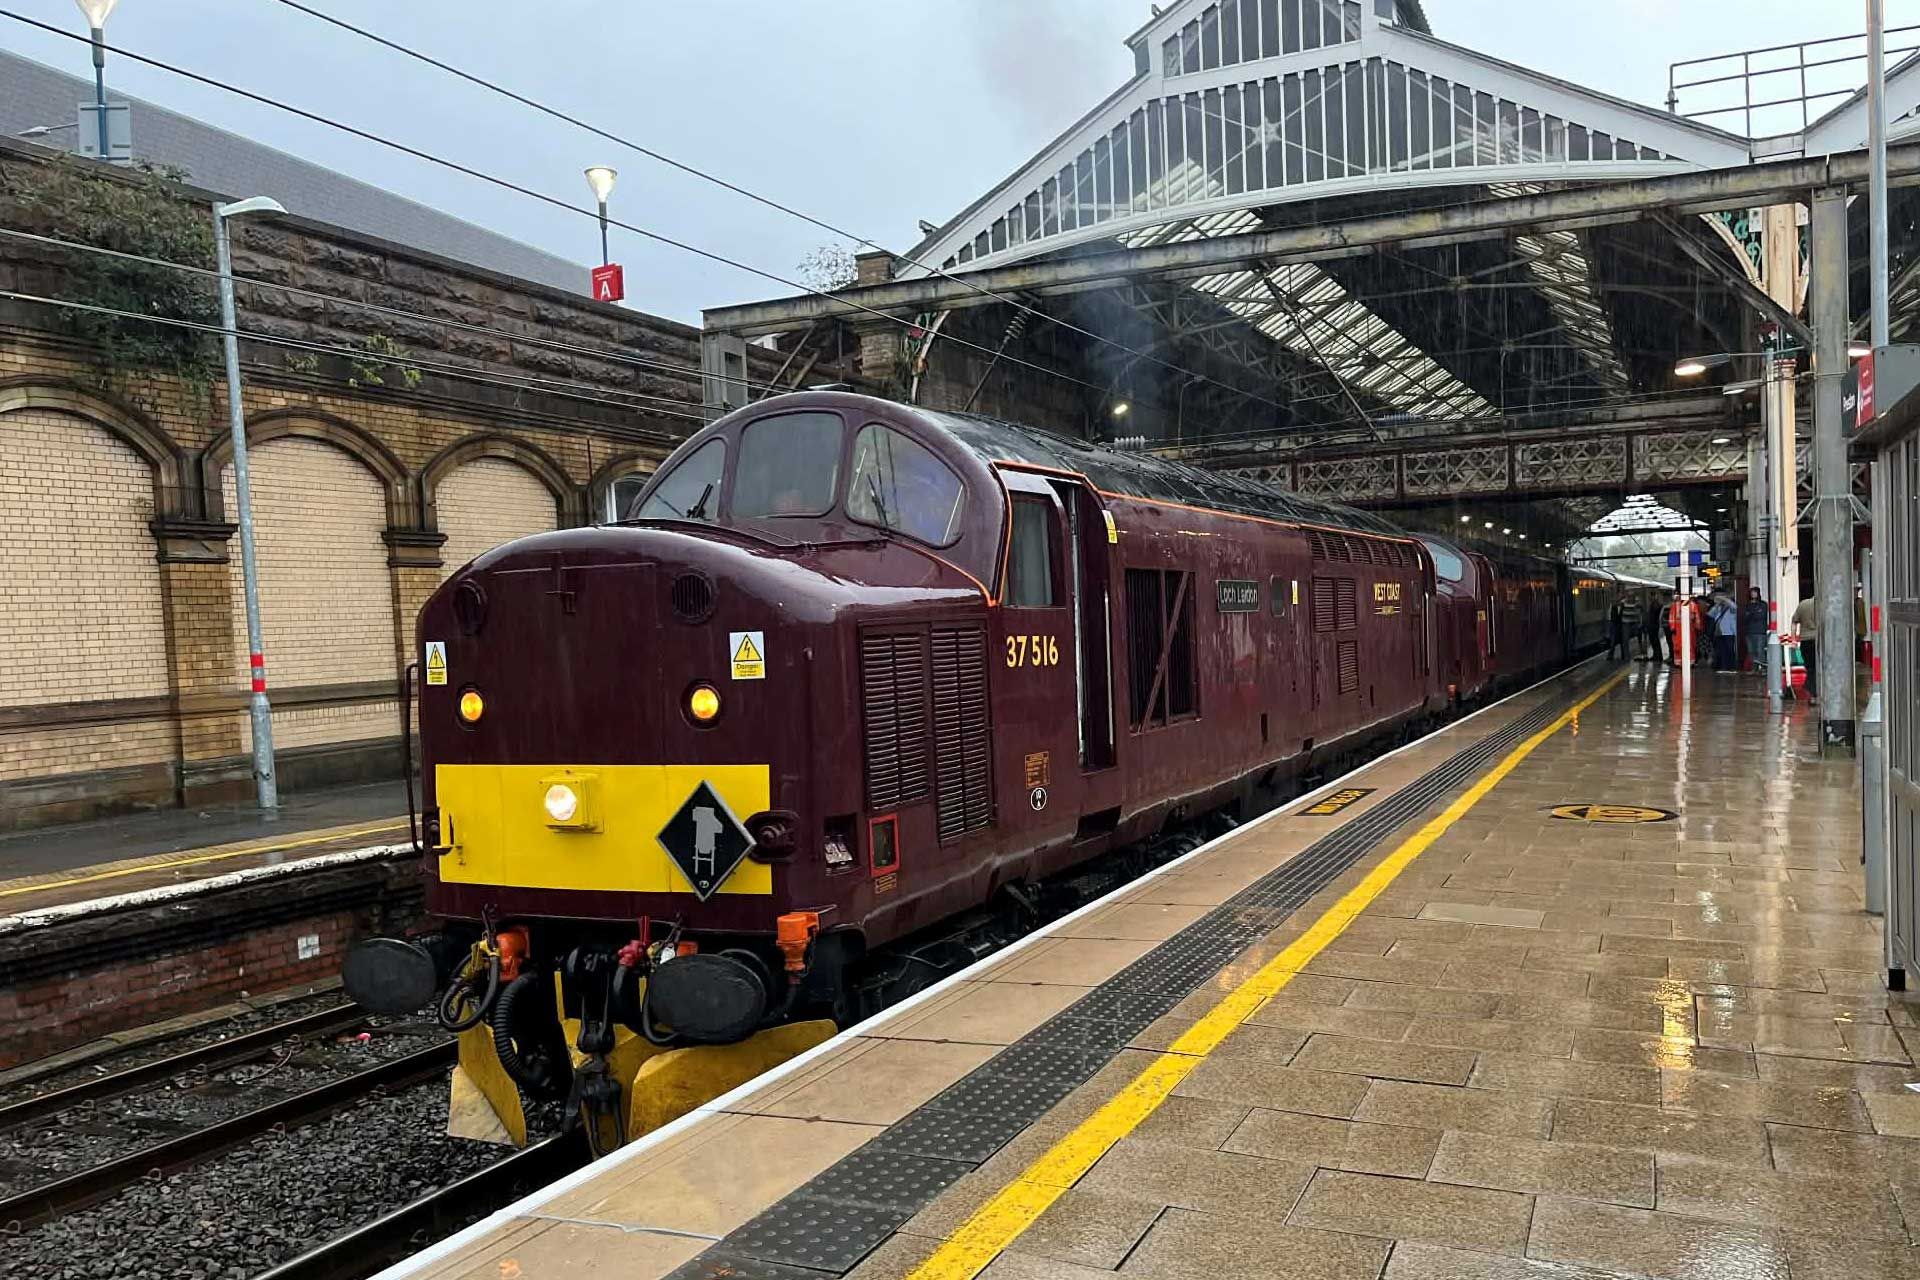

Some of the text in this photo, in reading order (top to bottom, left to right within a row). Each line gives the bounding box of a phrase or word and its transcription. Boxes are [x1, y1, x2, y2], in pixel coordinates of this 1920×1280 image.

[600, 280, 611, 301] A
[1219, 583, 1236, 604] Loch
[1006, 635, 1059, 668] 37 516
